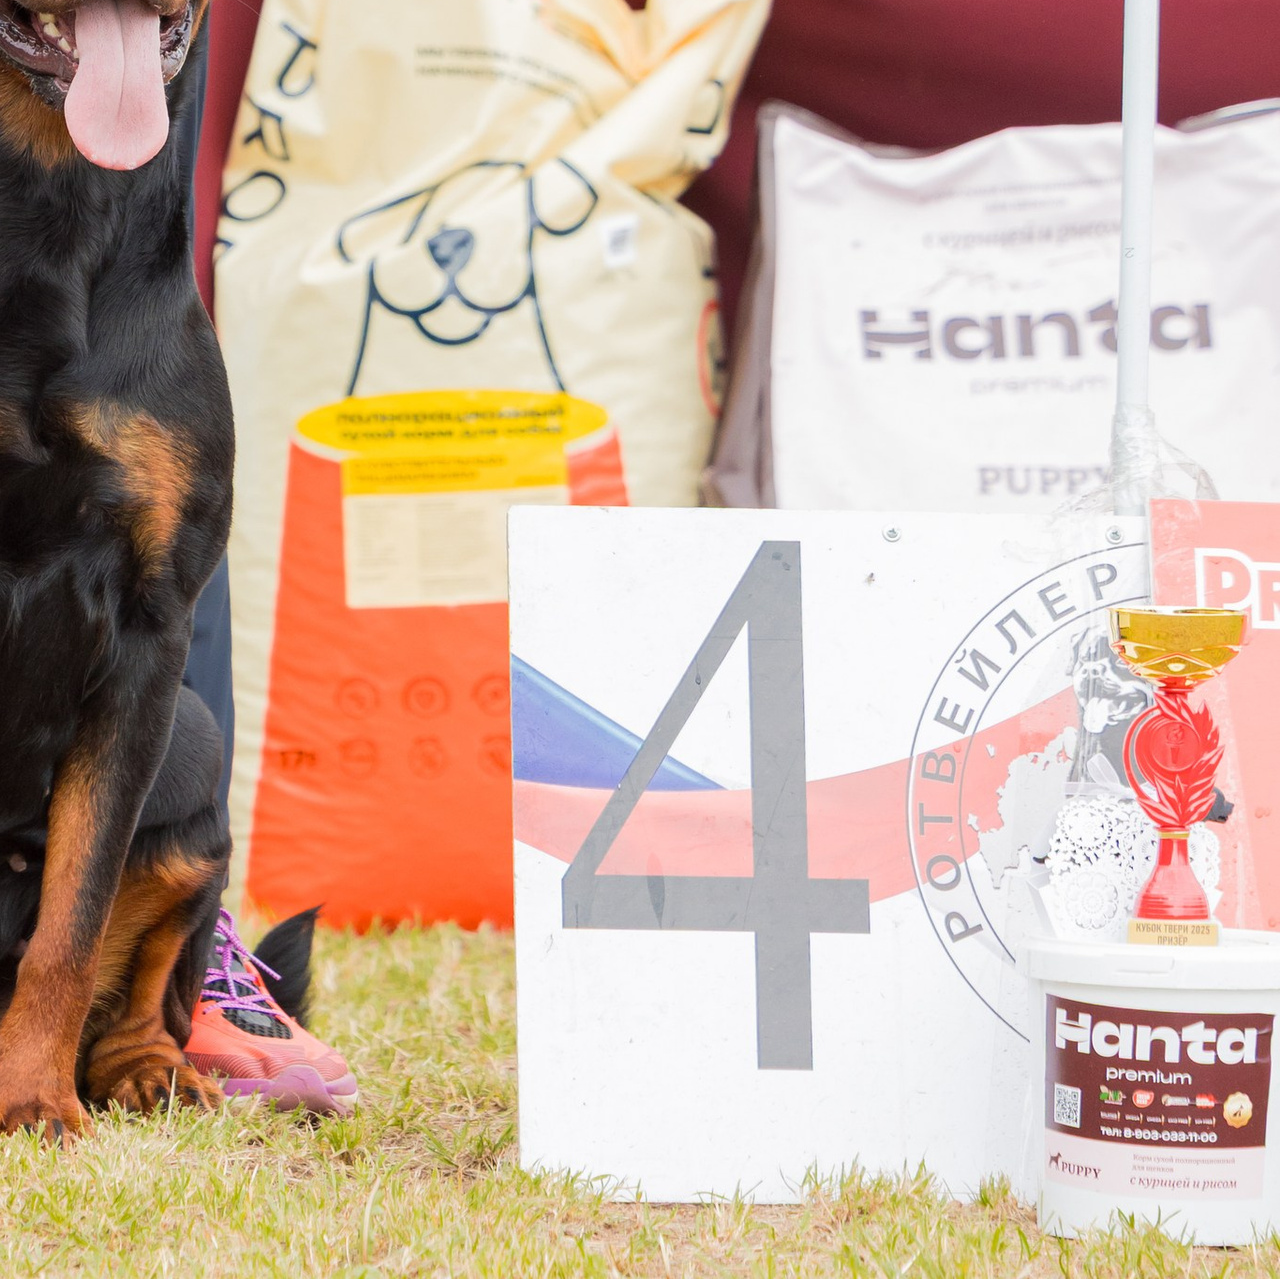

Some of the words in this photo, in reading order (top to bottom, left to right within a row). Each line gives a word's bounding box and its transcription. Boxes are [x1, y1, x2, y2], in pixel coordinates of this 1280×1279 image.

[918, 561, 1119, 945] РОТВЕЙЛЕР
[561, 540, 871, 1070] 4
[1135, 923, 1162, 933] КУБОК
[1164, 924, 1189, 934] ТВЕРИ
[1191, 925, 1211, 935] 2025
[1055, 1007, 1258, 1065] Hanta
[1106, 1065, 1193, 1086] premium
[1061, 1160, 1102, 1180] PUPPY
[1129, 1176, 1137, 1185] с
[1138, 1176, 1190, 1192] курицей
[1192, 1179, 1200, 1189] и
[1201, 1179, 1238, 1193] рисом
